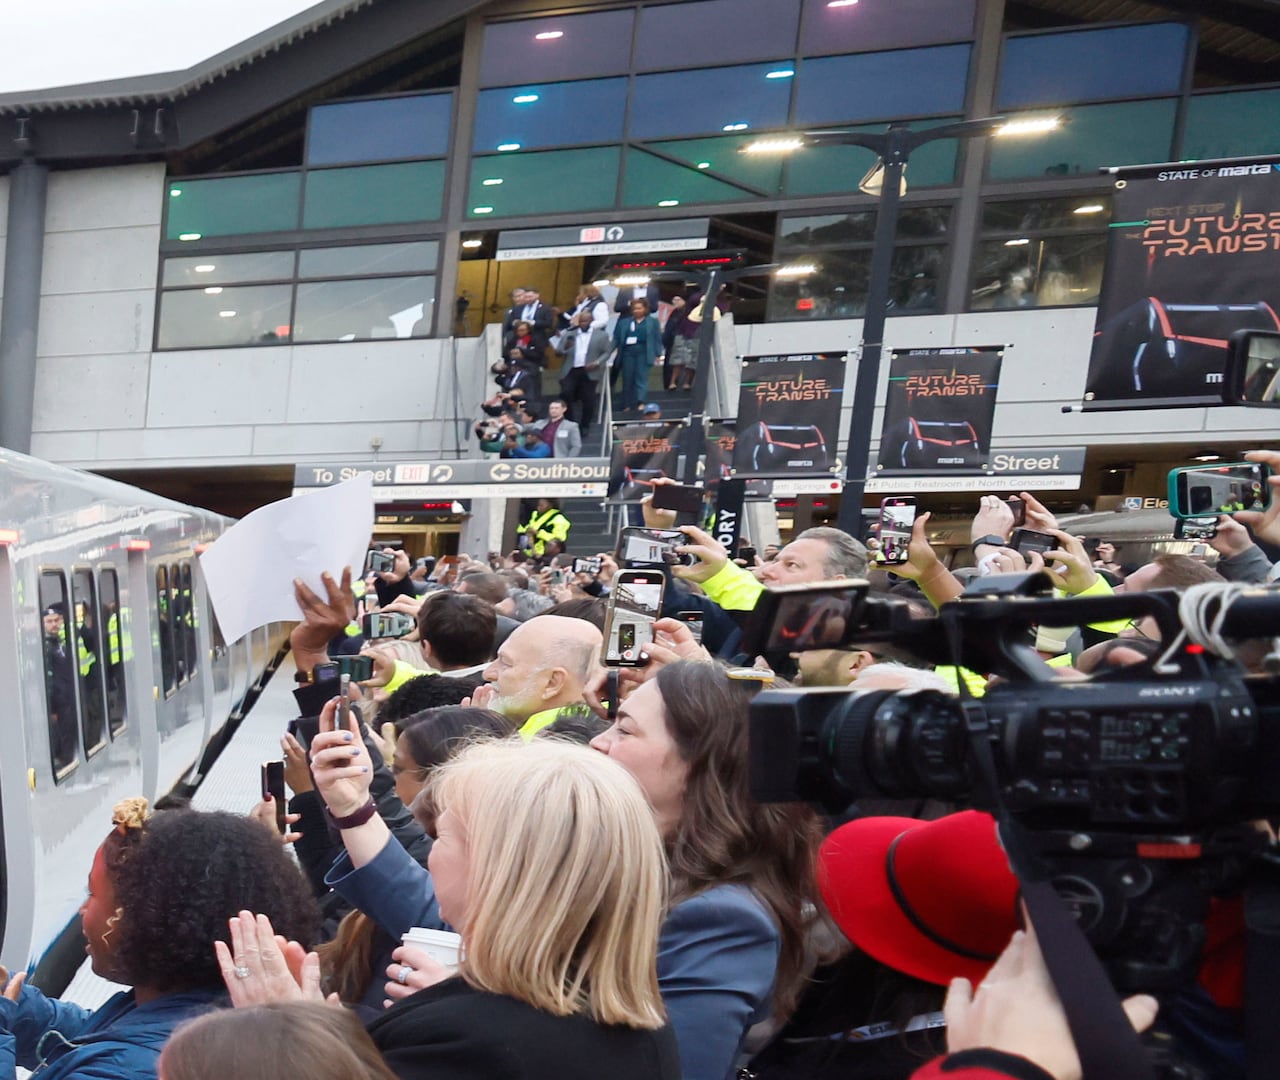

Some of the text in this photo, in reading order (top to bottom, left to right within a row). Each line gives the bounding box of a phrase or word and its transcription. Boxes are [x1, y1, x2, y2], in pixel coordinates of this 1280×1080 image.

[1157, 164, 1271, 182] STATE OF marta
[1142, 233, 1280, 257] TRANSI
[756, 379, 827, 392] FUTURE
[906, 374, 980, 387] FUTURE
[756, 389, 832, 402] TRANSIT
[906, 384, 986, 397] TRANSIT
[992, 453, 1060, 471] Street
[313, 468, 333, 483] To
[340, 467, 392, 483] Stet
[881, 481, 912, 489] Public
[914, 480, 963, 488] Restroom
[978, 479, 1008, 487] North
[1009, 478, 1065, 487] Concourse
[718, 509, 737, 554] ORY
